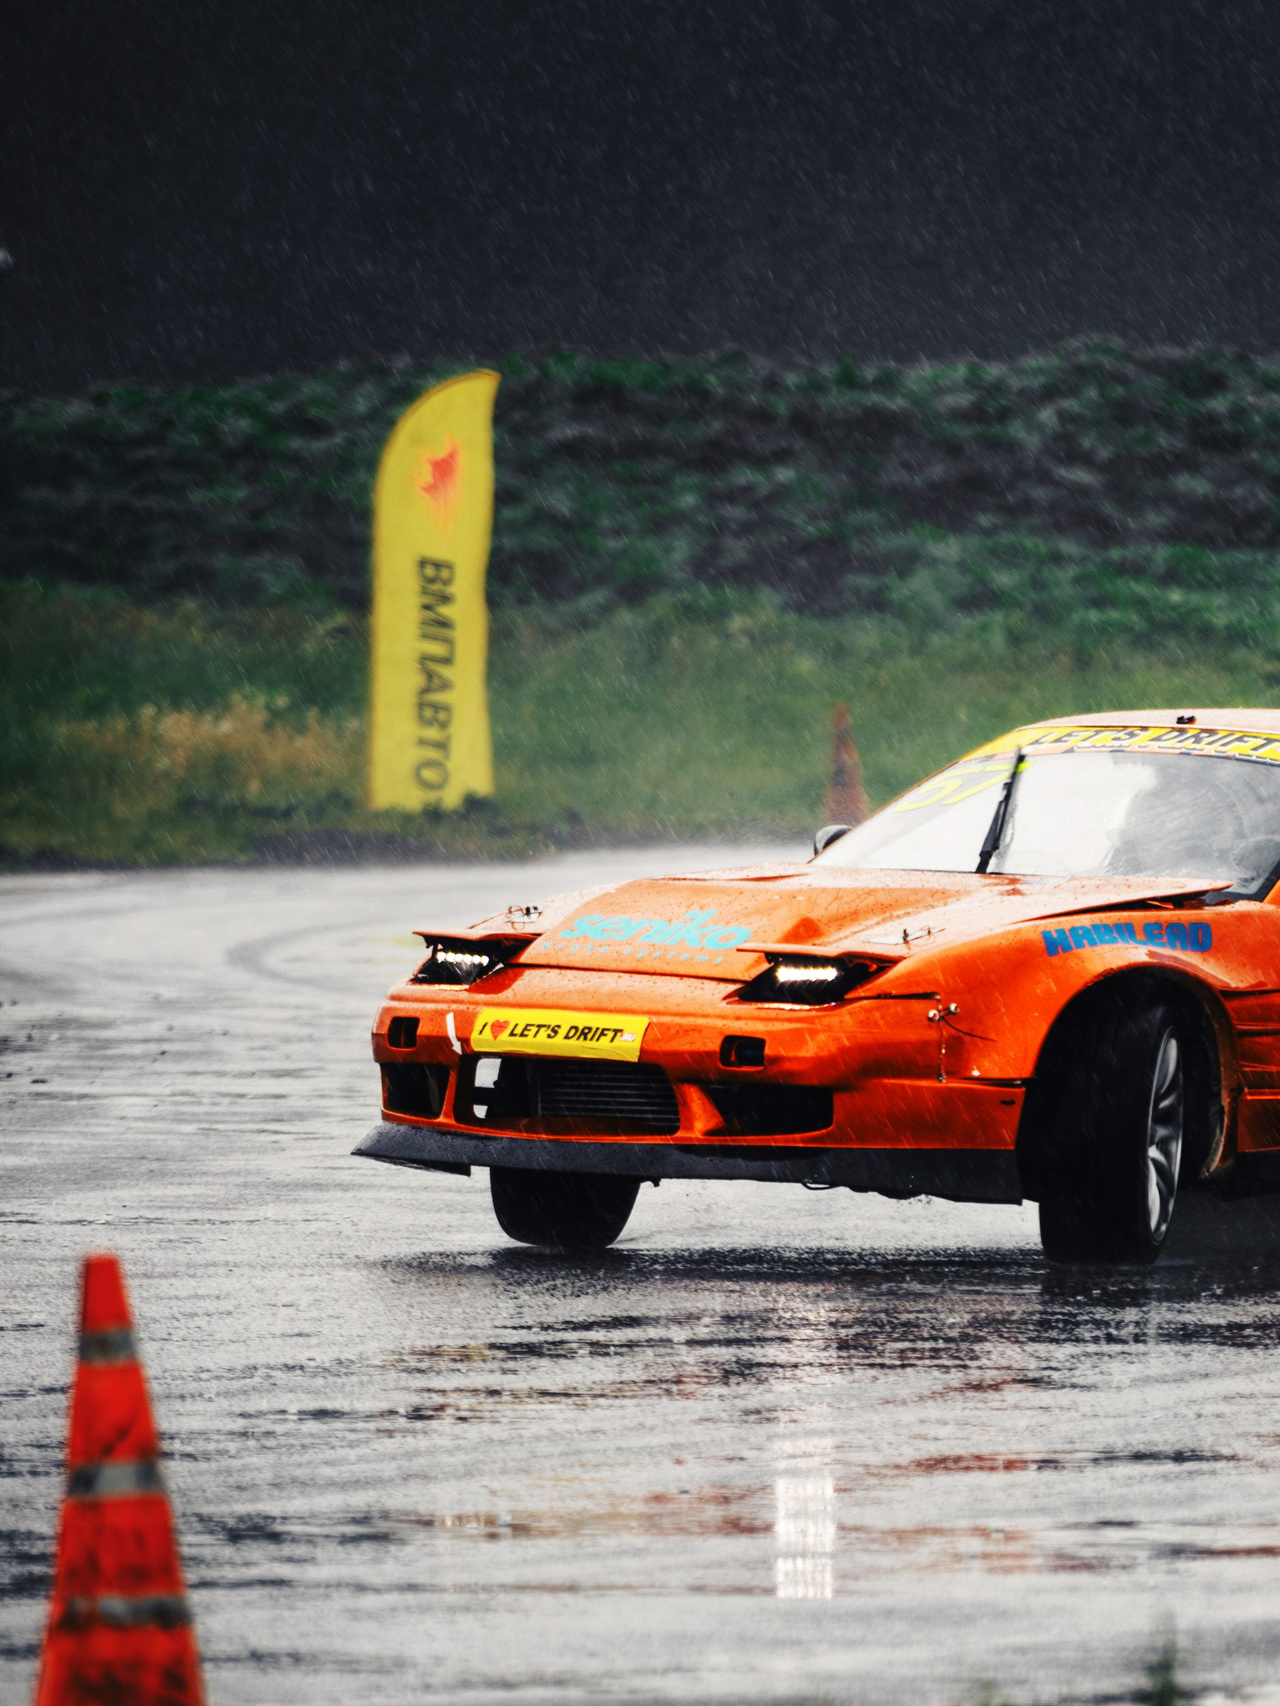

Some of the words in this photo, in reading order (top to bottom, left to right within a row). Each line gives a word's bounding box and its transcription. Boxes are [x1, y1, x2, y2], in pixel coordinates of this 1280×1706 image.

[415, 556, 455, 792] ВМПАВТО
[558, 909, 752, 950] seniko
[1041, 922, 1213, 957] HABILEAD
[508, 1023, 561, 1039] LET'S
